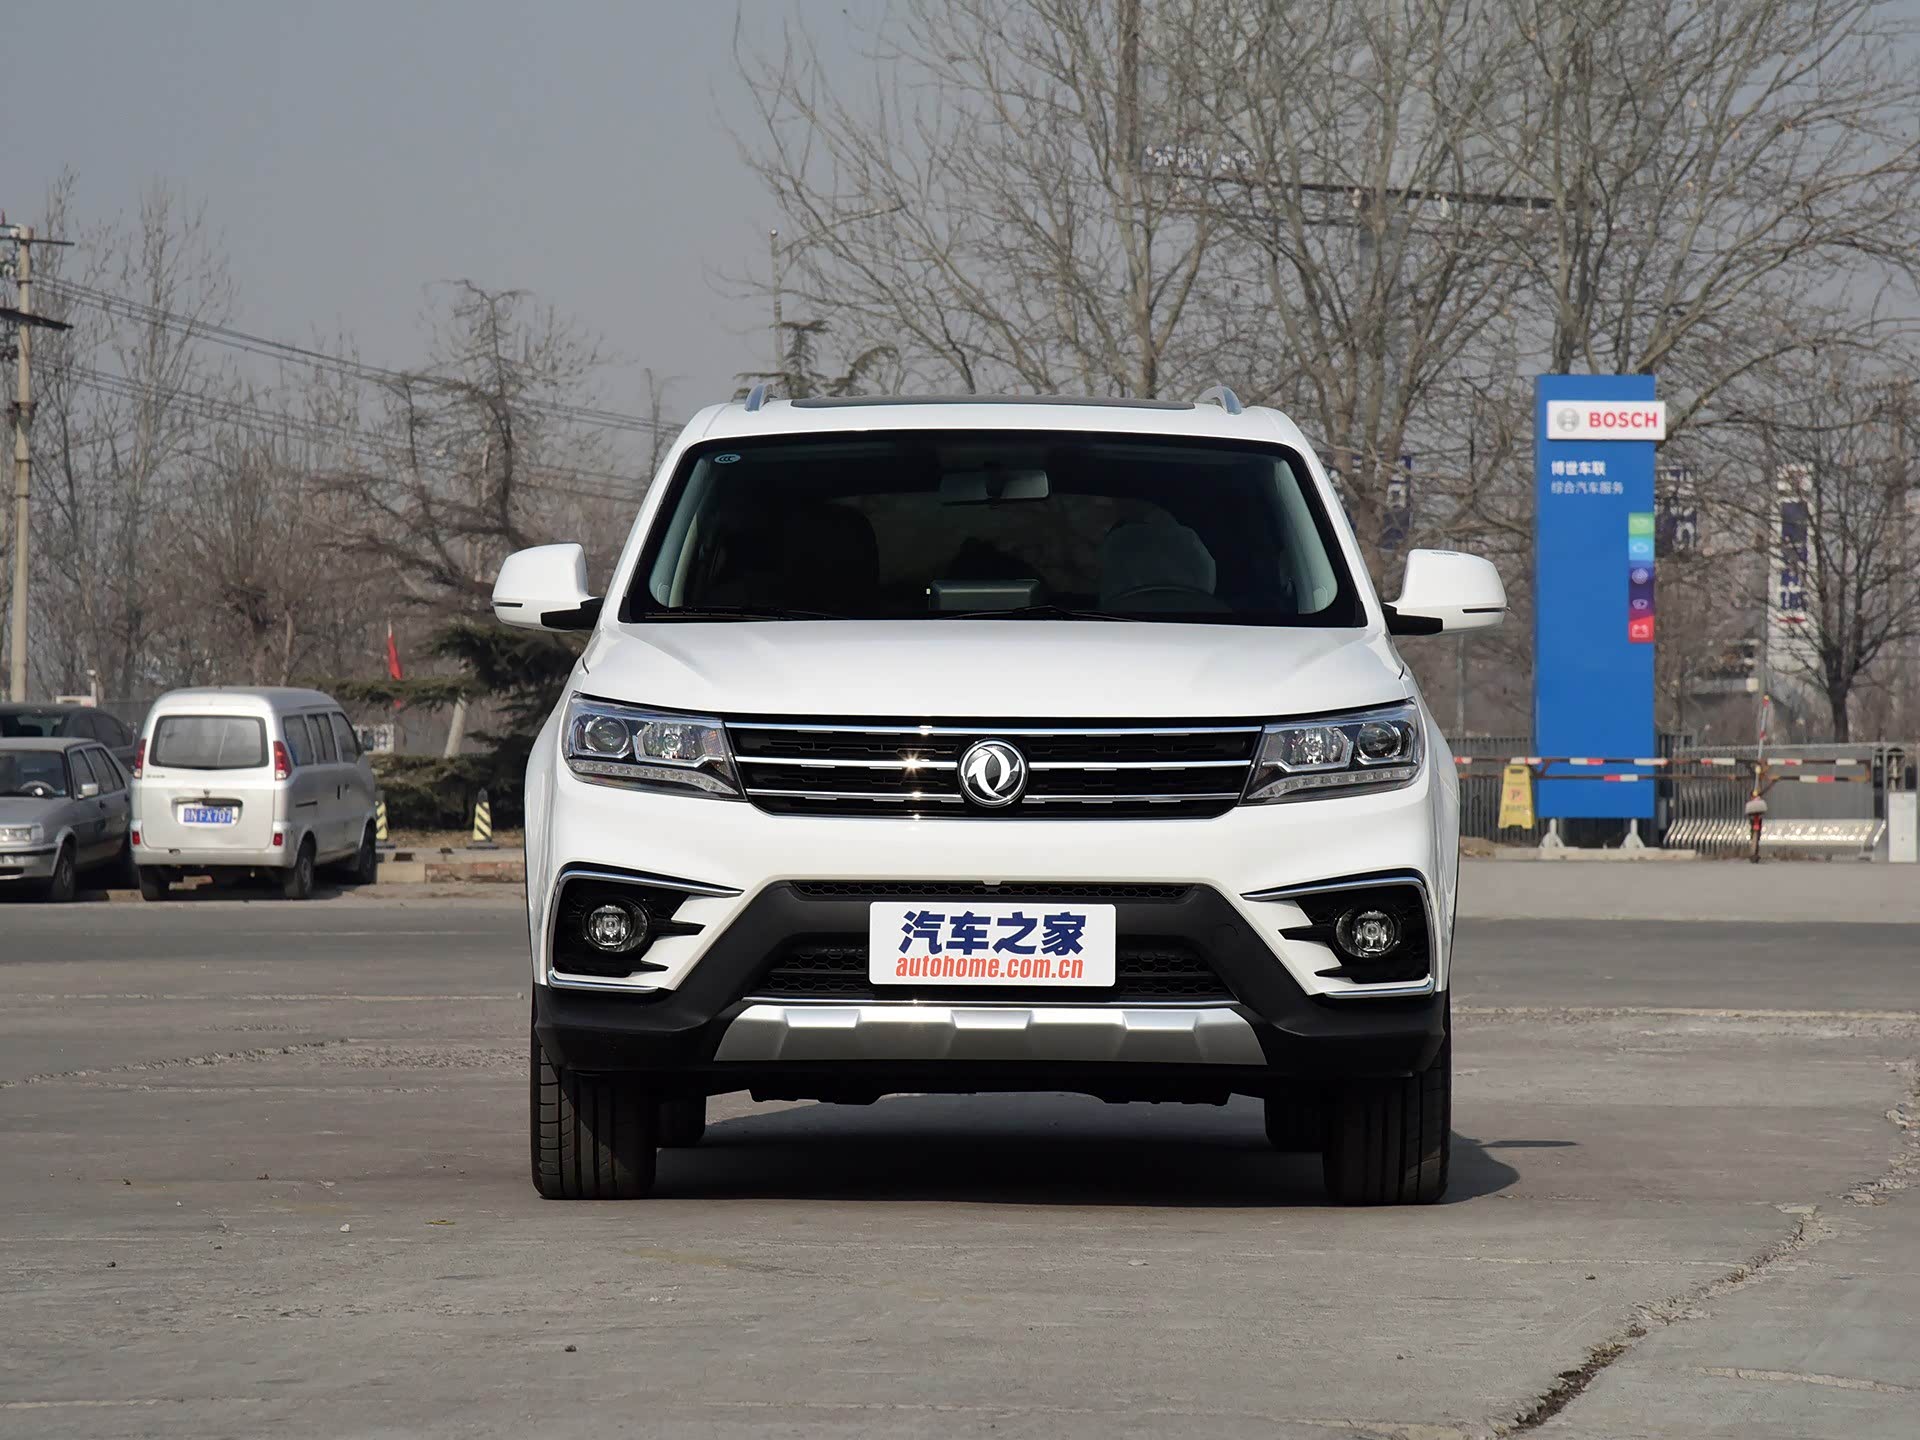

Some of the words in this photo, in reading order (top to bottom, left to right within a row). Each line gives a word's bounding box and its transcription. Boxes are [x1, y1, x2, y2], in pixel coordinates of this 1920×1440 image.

[1588, 412, 1658, 429] BOSCH
[1551, 460, 1607, 476] 博世车联
[1551, 480, 1624, 495] 综合汽车服务
[898, 910, 1087, 956] 汽车之家
[895, 955, 1084, 979] autohome.com.cn
